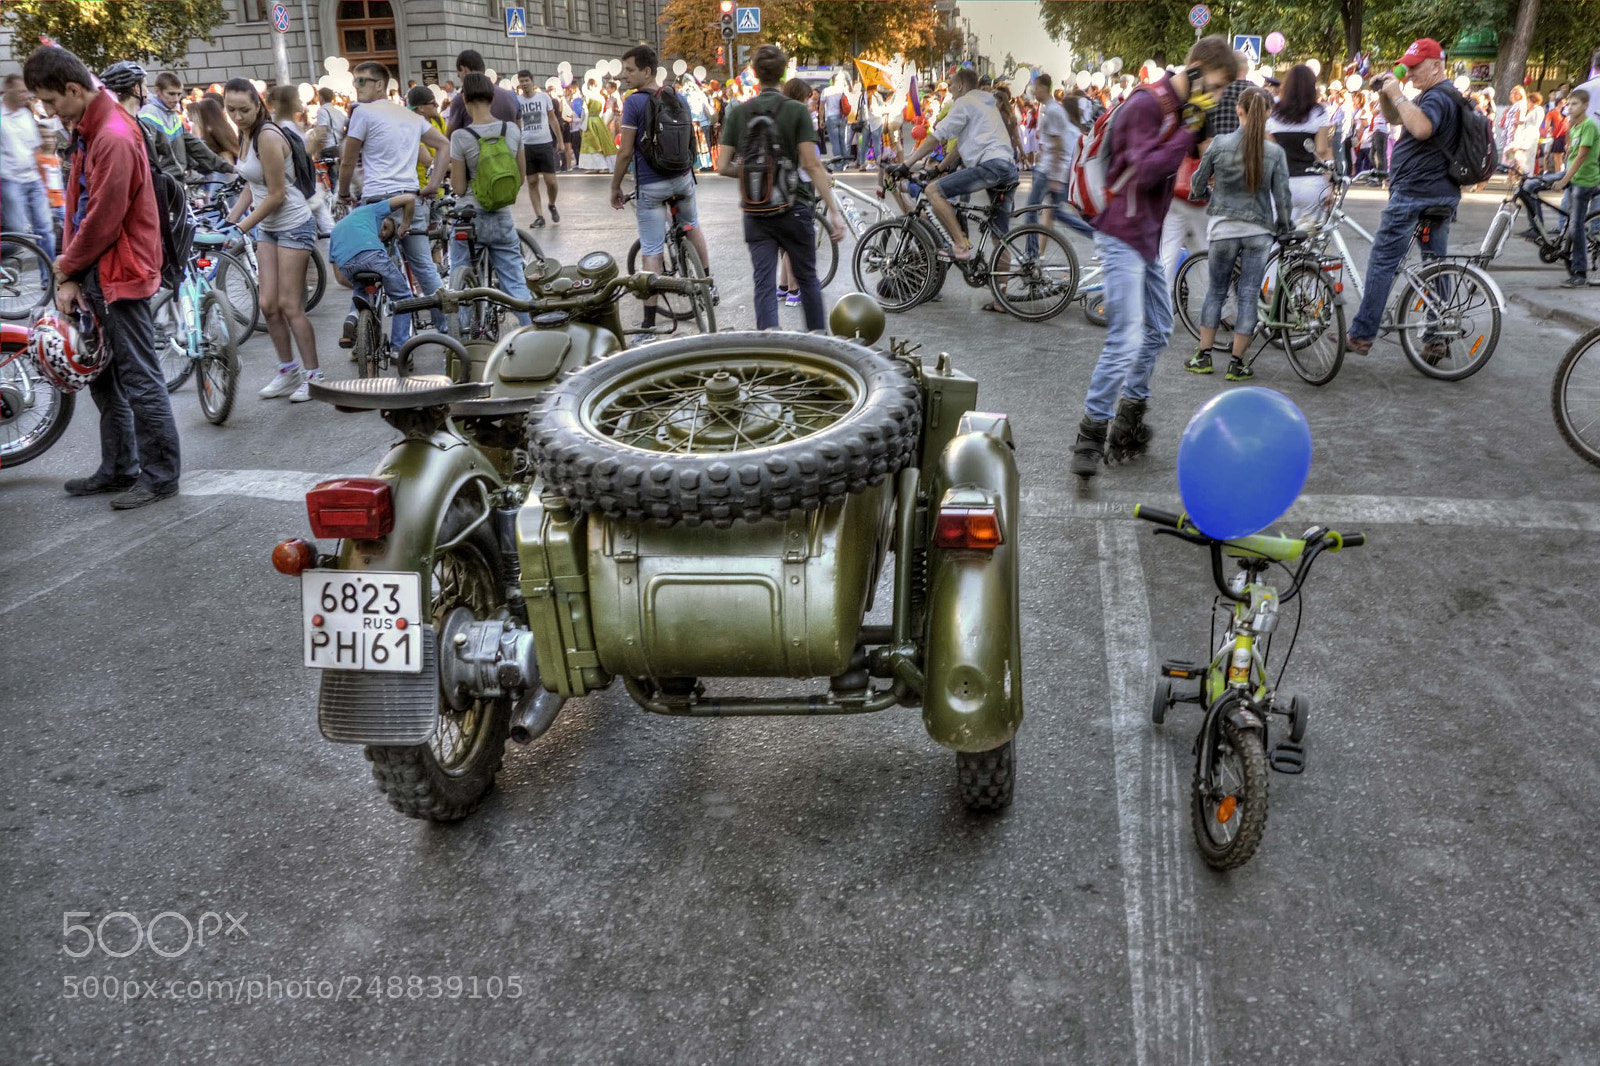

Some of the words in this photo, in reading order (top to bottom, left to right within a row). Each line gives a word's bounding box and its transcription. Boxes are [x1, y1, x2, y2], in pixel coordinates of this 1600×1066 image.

[321, 582, 401, 614] 6823
[363, 617, 393, 629] RUS
[310, 630, 357, 663] PH
[371, 632, 410, 665] 61
